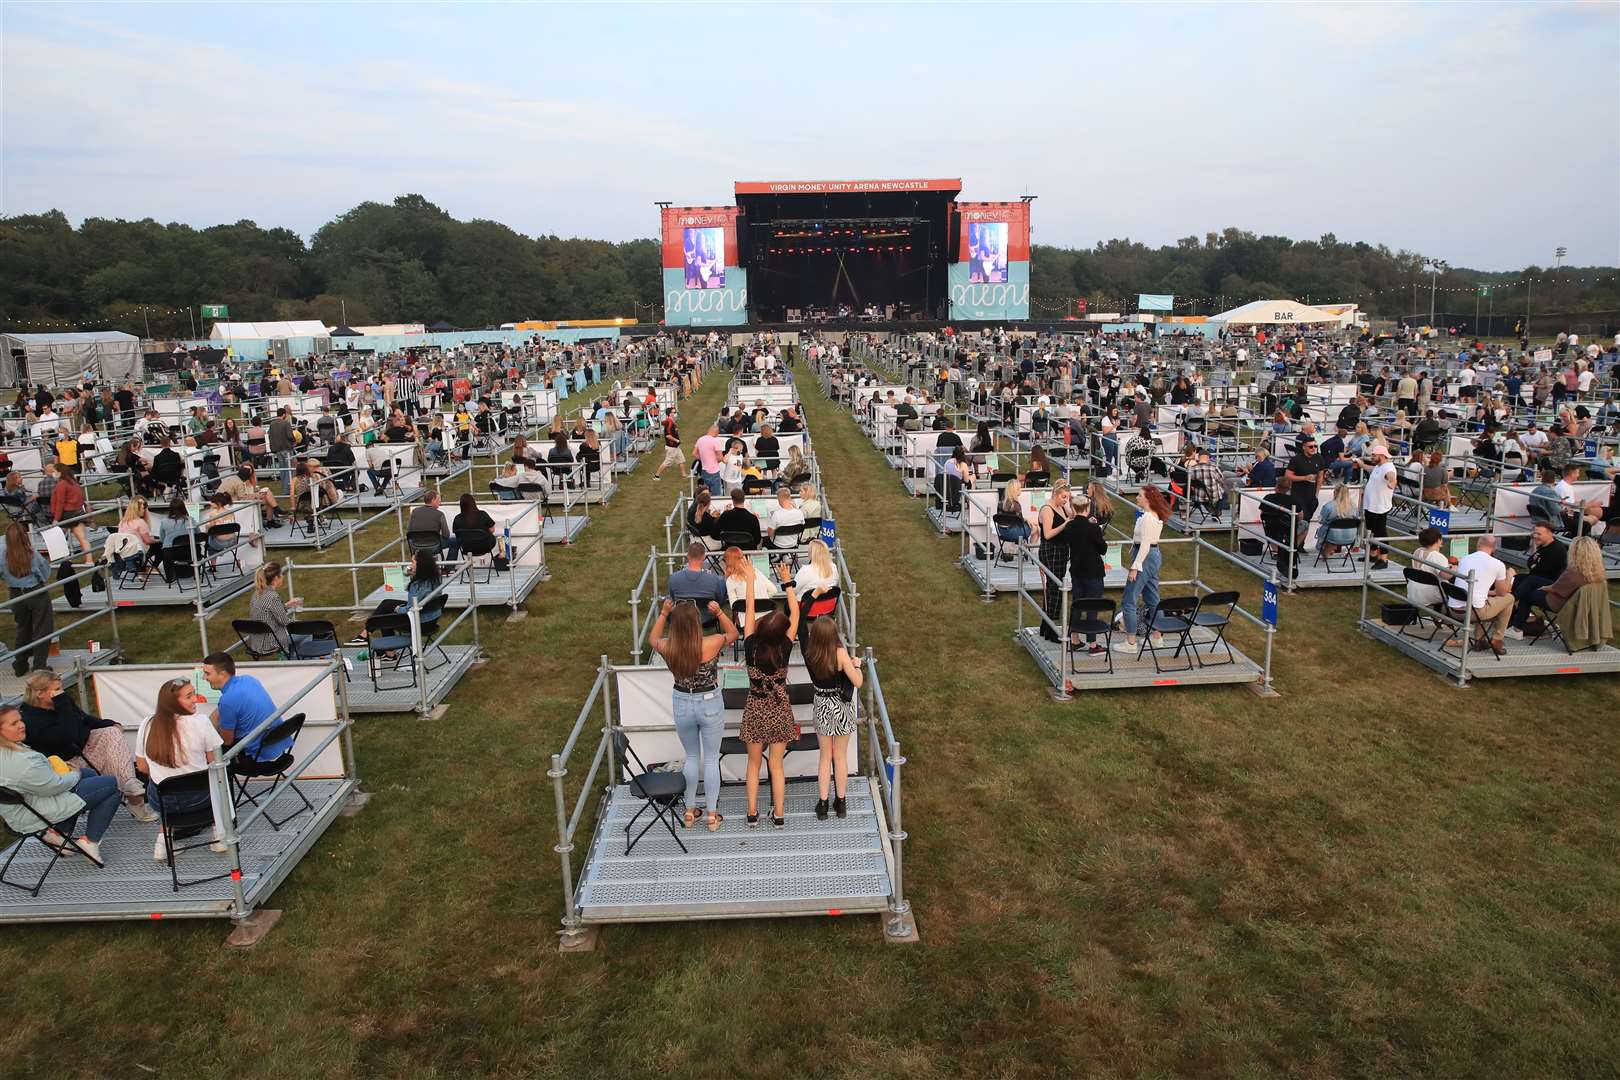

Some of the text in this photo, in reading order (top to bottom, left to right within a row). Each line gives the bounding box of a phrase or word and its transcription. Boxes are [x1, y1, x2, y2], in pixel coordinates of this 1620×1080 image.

[798, 183, 826, 191] MONEY
[881, 181, 929, 190] NEWCASTLE
[1274, 311, 1294, 320] BAR
[1430, 516, 1447, 528] 366
[822, 527, 835, 538] 368
[1263, 590, 1277, 606] 384
